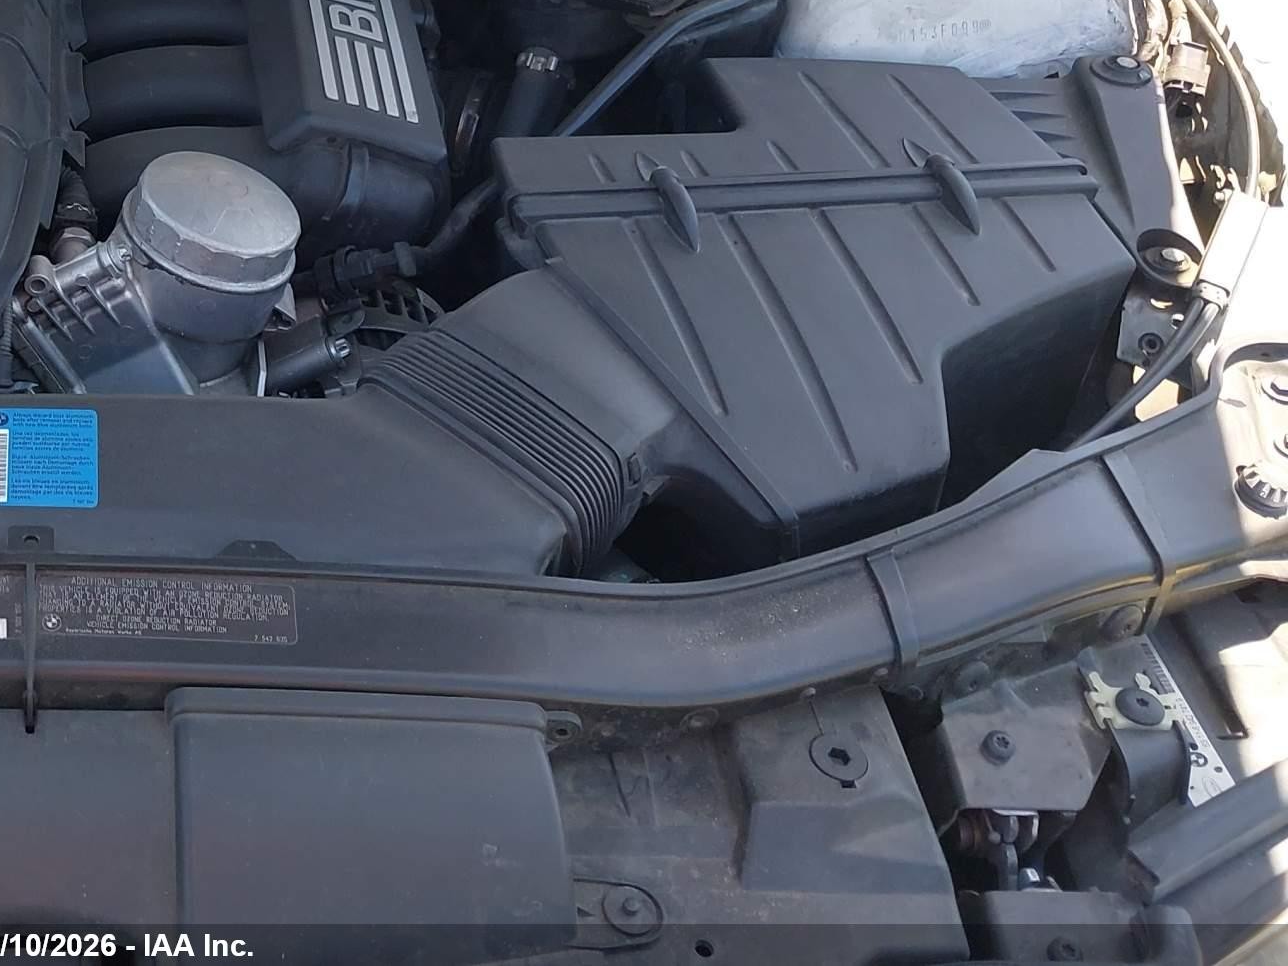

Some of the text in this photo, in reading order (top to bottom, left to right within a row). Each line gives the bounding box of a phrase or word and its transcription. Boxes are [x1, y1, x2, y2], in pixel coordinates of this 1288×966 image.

[71, 577, 253, 594] ADDITIONAL EMISSION CONTROL INFORMATION
[86, 620, 227, 634] VEHICLE EMISSION CONTROL INFORMATION
[184, 618, 217, 626] RADIATOR
